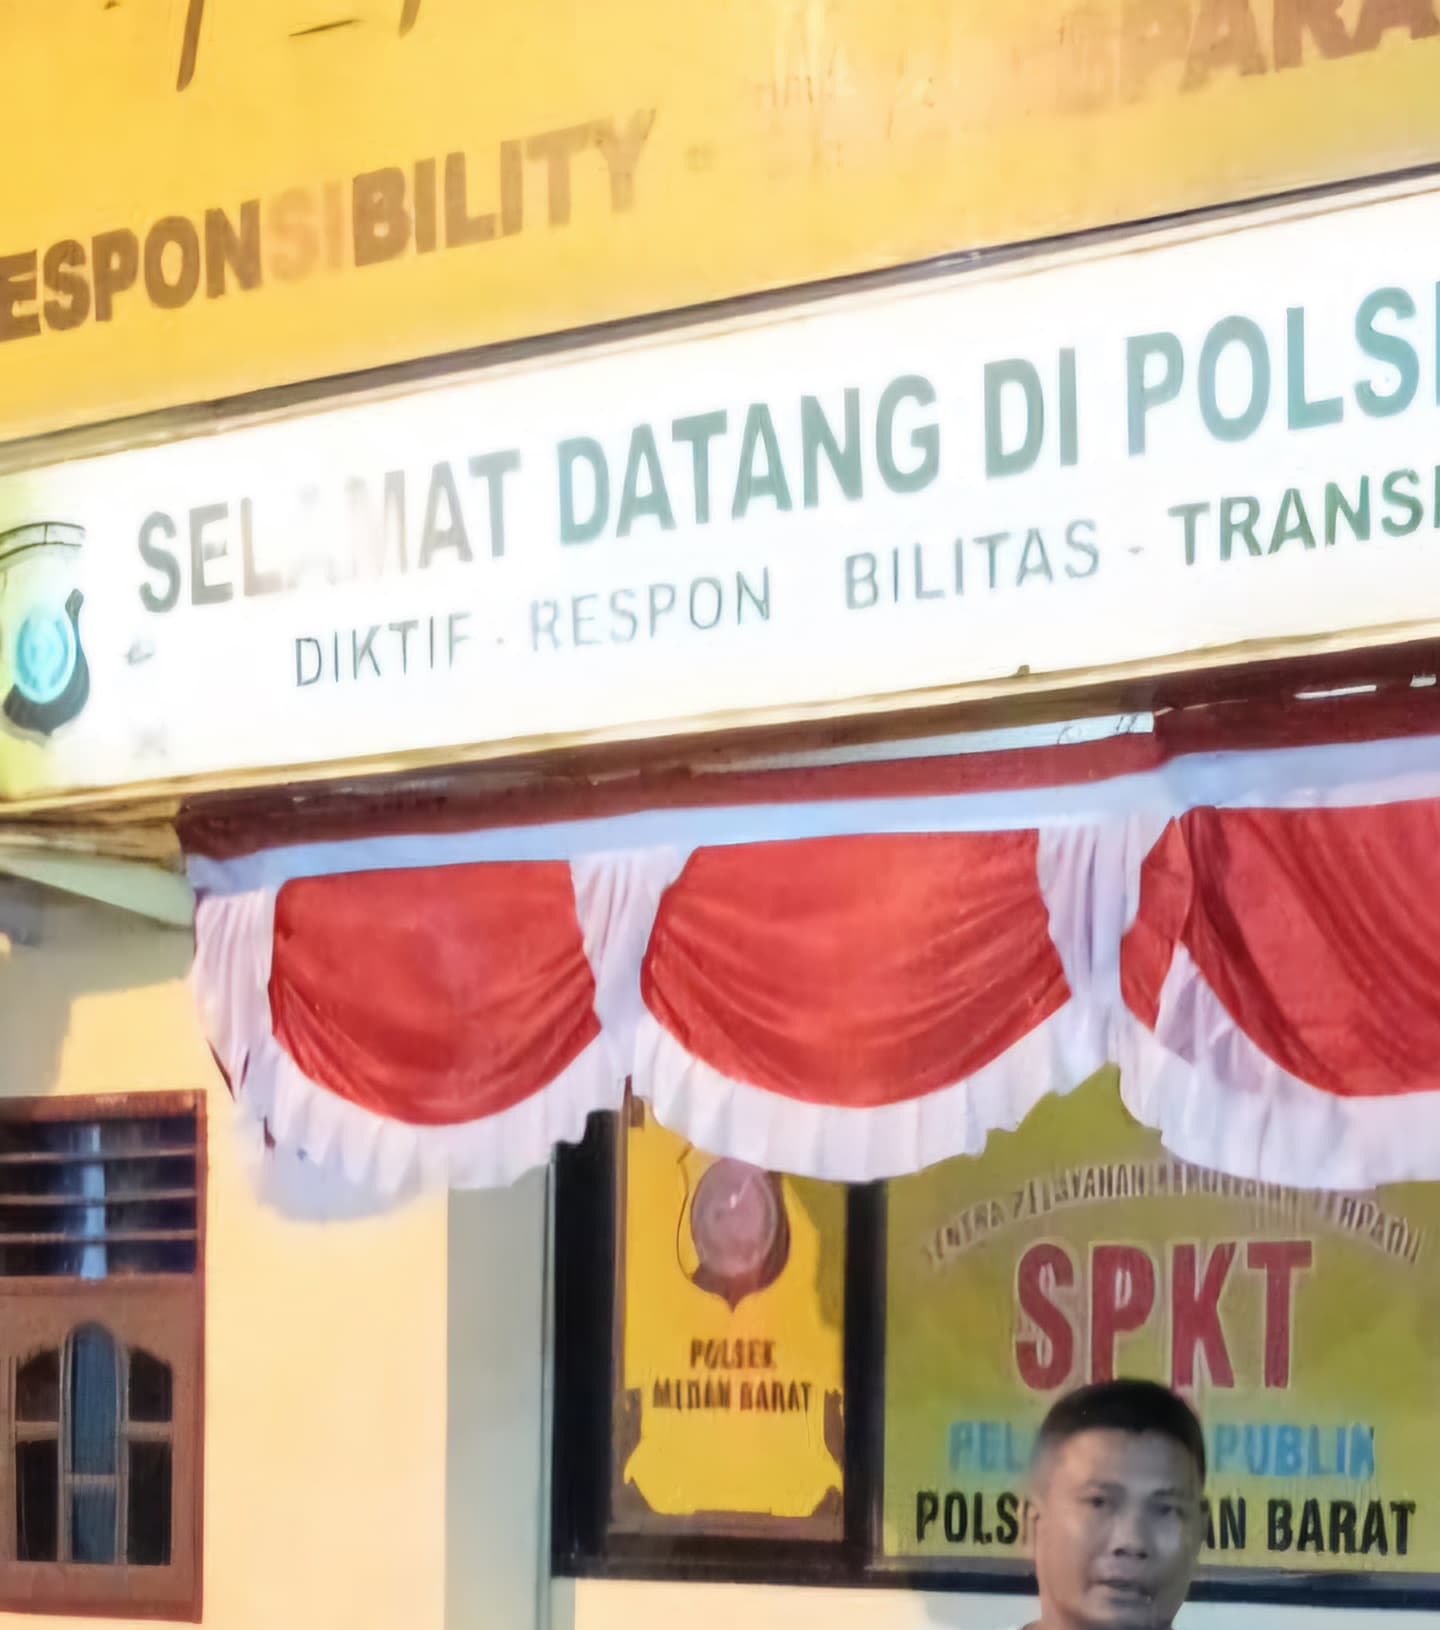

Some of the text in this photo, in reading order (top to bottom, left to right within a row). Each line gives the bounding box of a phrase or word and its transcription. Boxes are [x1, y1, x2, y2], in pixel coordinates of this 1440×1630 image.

[556, 374, 941, 547] DATANG
[984, 348, 1079, 479] DI
[844, 518, 1100, 610] BILITAS
[1016, 1240, 1312, 1392] SPKT
[915, 1489, 1036, 1545] POLS
[1266, 1499, 1416, 1556] BARAT
